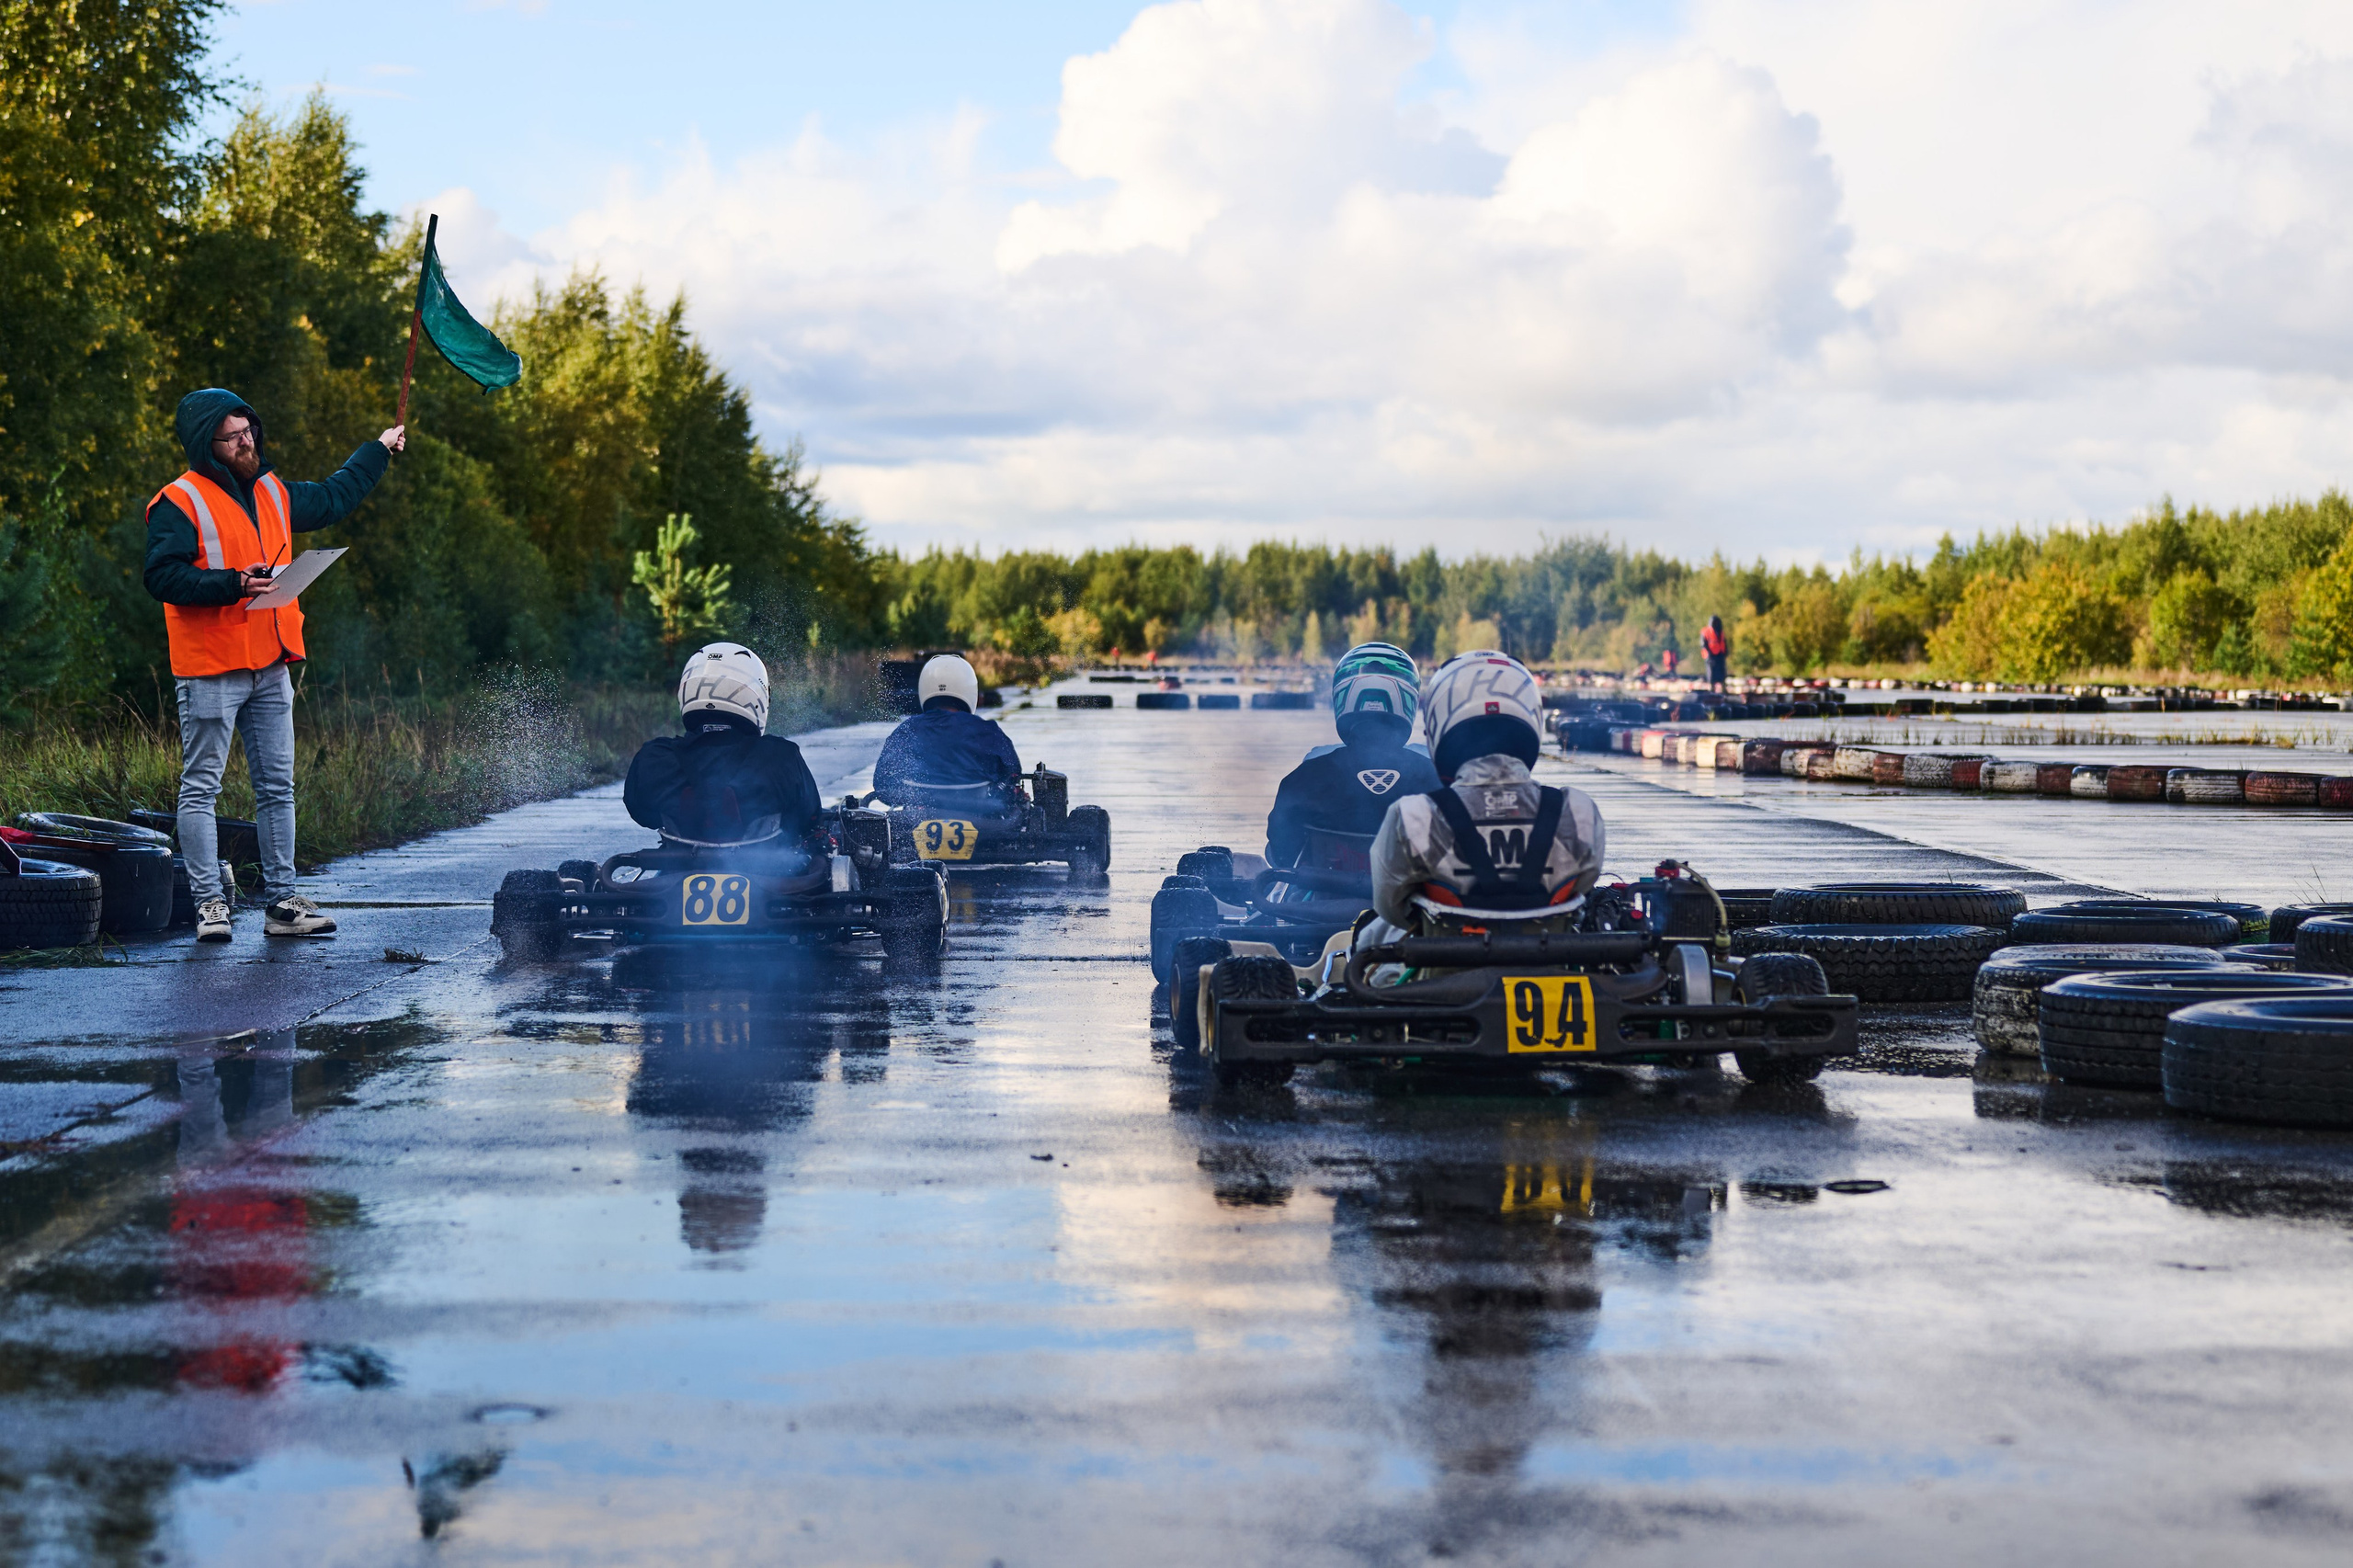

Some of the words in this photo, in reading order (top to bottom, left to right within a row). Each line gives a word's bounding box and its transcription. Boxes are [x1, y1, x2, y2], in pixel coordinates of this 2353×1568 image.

[926, 821, 965, 851] 93
[684, 875, 748, 923] 88
[1514, 981, 1587, 1047] 94
